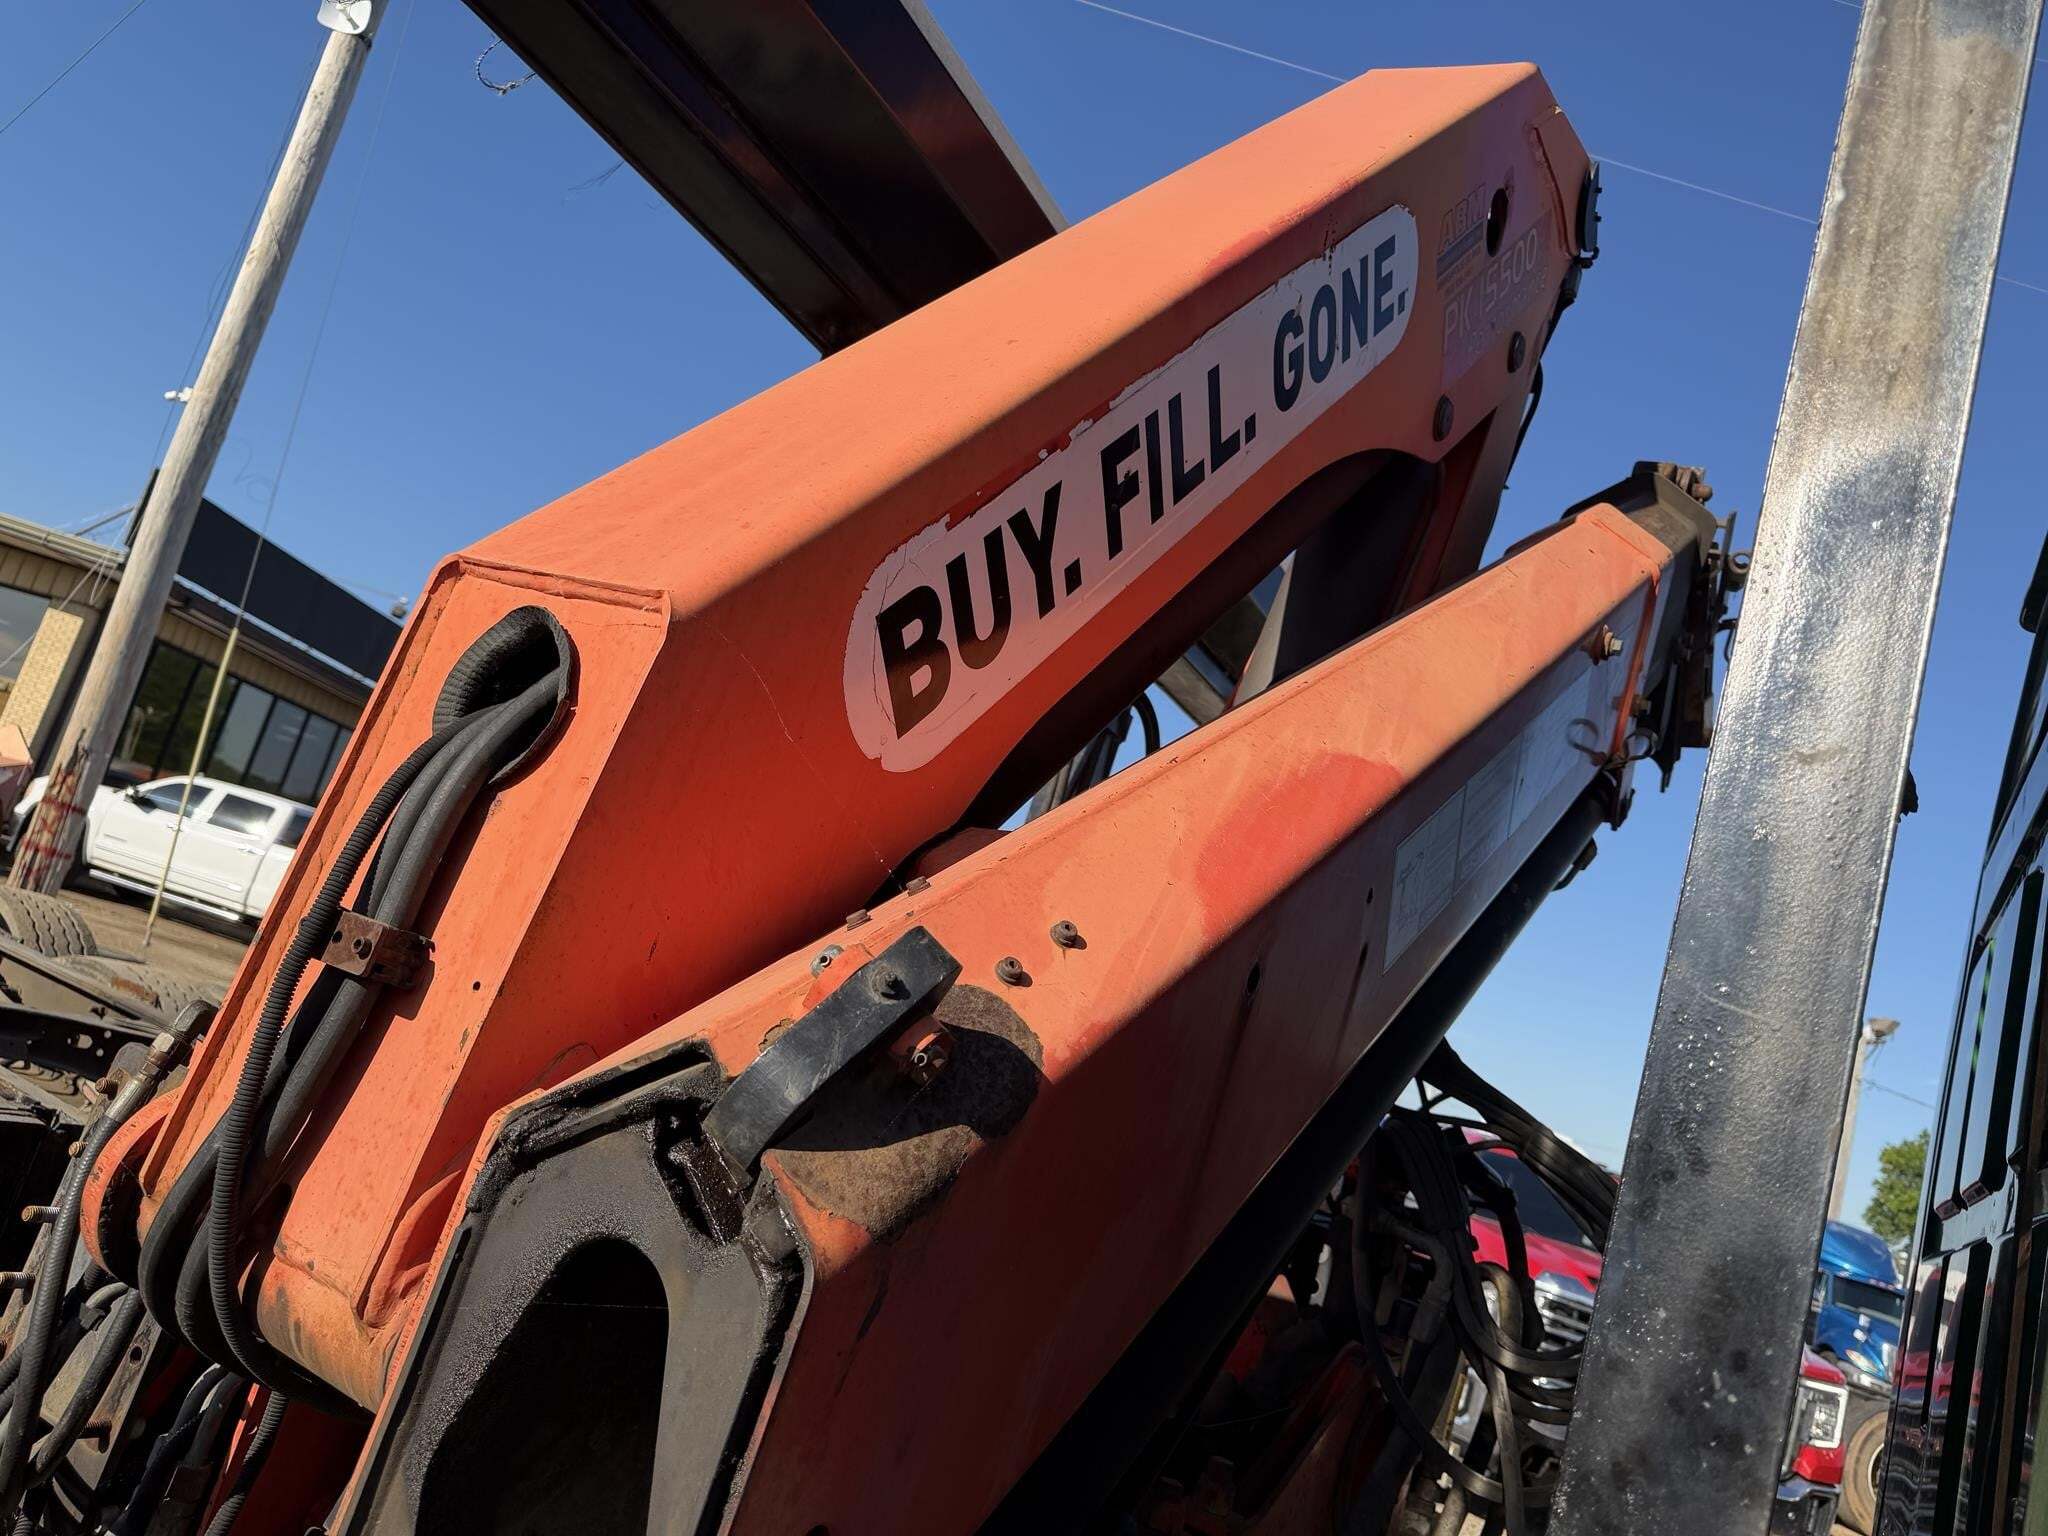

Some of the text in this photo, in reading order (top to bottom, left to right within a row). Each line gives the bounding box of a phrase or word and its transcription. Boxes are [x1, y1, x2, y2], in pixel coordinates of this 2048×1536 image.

[1444, 286, 1474, 353] PK
[1479, 227, 1538, 316] 15500
[875, 233, 1409, 740] BUY. FILL. GONE.
